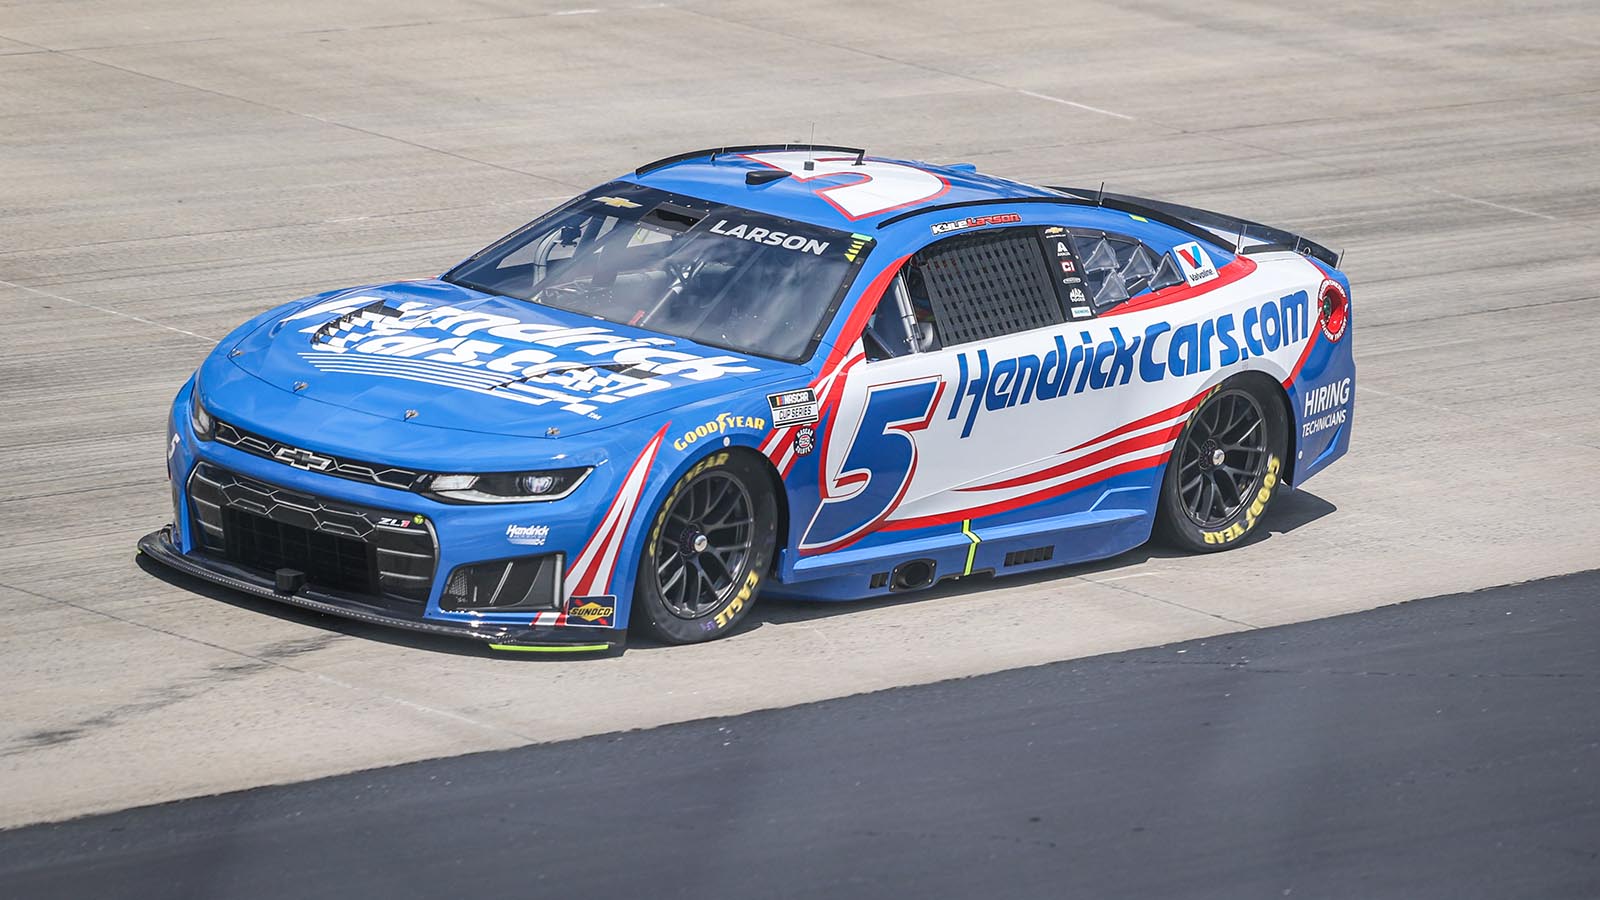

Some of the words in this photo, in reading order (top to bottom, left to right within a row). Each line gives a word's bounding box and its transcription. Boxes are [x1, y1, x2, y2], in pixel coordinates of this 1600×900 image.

[709, 219, 830, 256] LARSON
[1189, 269, 1214, 282] Valvoline
[947, 288, 1310, 439] HendrickCars.com
[784, 392, 809, 404] NASCAR
[1303, 378, 1351, 418] HIRING
[780, 410, 790, 419] CUP
[791, 406, 811, 417] SERIES
[1302, 410, 1347, 438] TECHNICIANS
[801, 376, 945, 552] 5
[378, 517, 411, 528] ZL1
[506, 524, 550, 538] Hendrick
[713, 569, 760, 629] EAGLE
[570, 606, 613, 617] SUNOCO
